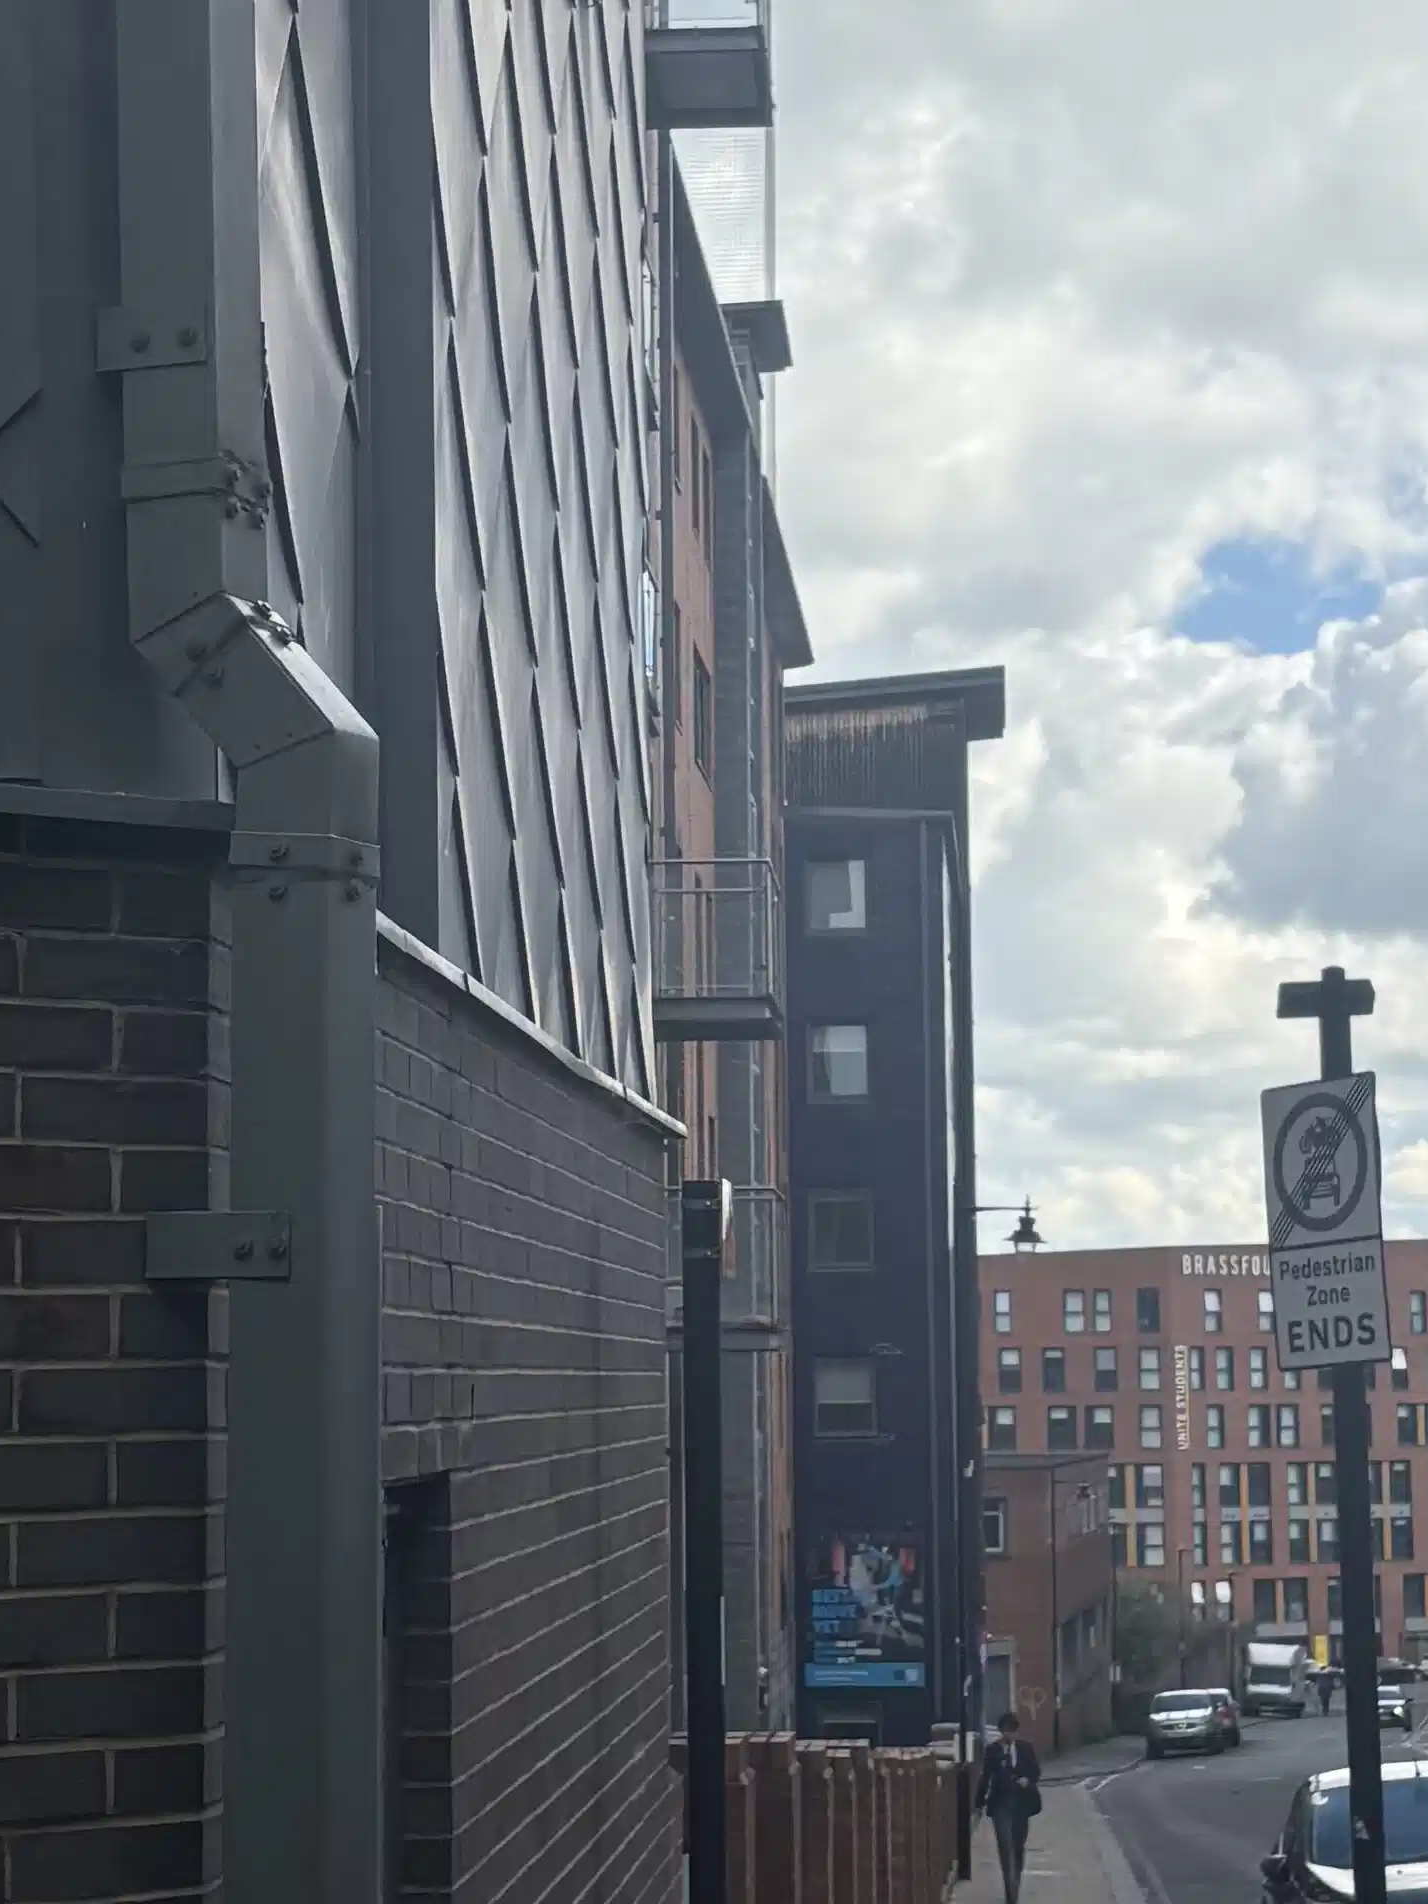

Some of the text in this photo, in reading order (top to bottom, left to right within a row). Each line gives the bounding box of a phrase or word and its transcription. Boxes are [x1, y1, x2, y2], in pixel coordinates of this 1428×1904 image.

[1279, 1252, 1375, 1280] Pedestrian
[1306, 1285, 1351, 1307] Zone
[1288, 1312, 1376, 1353] ENDS
